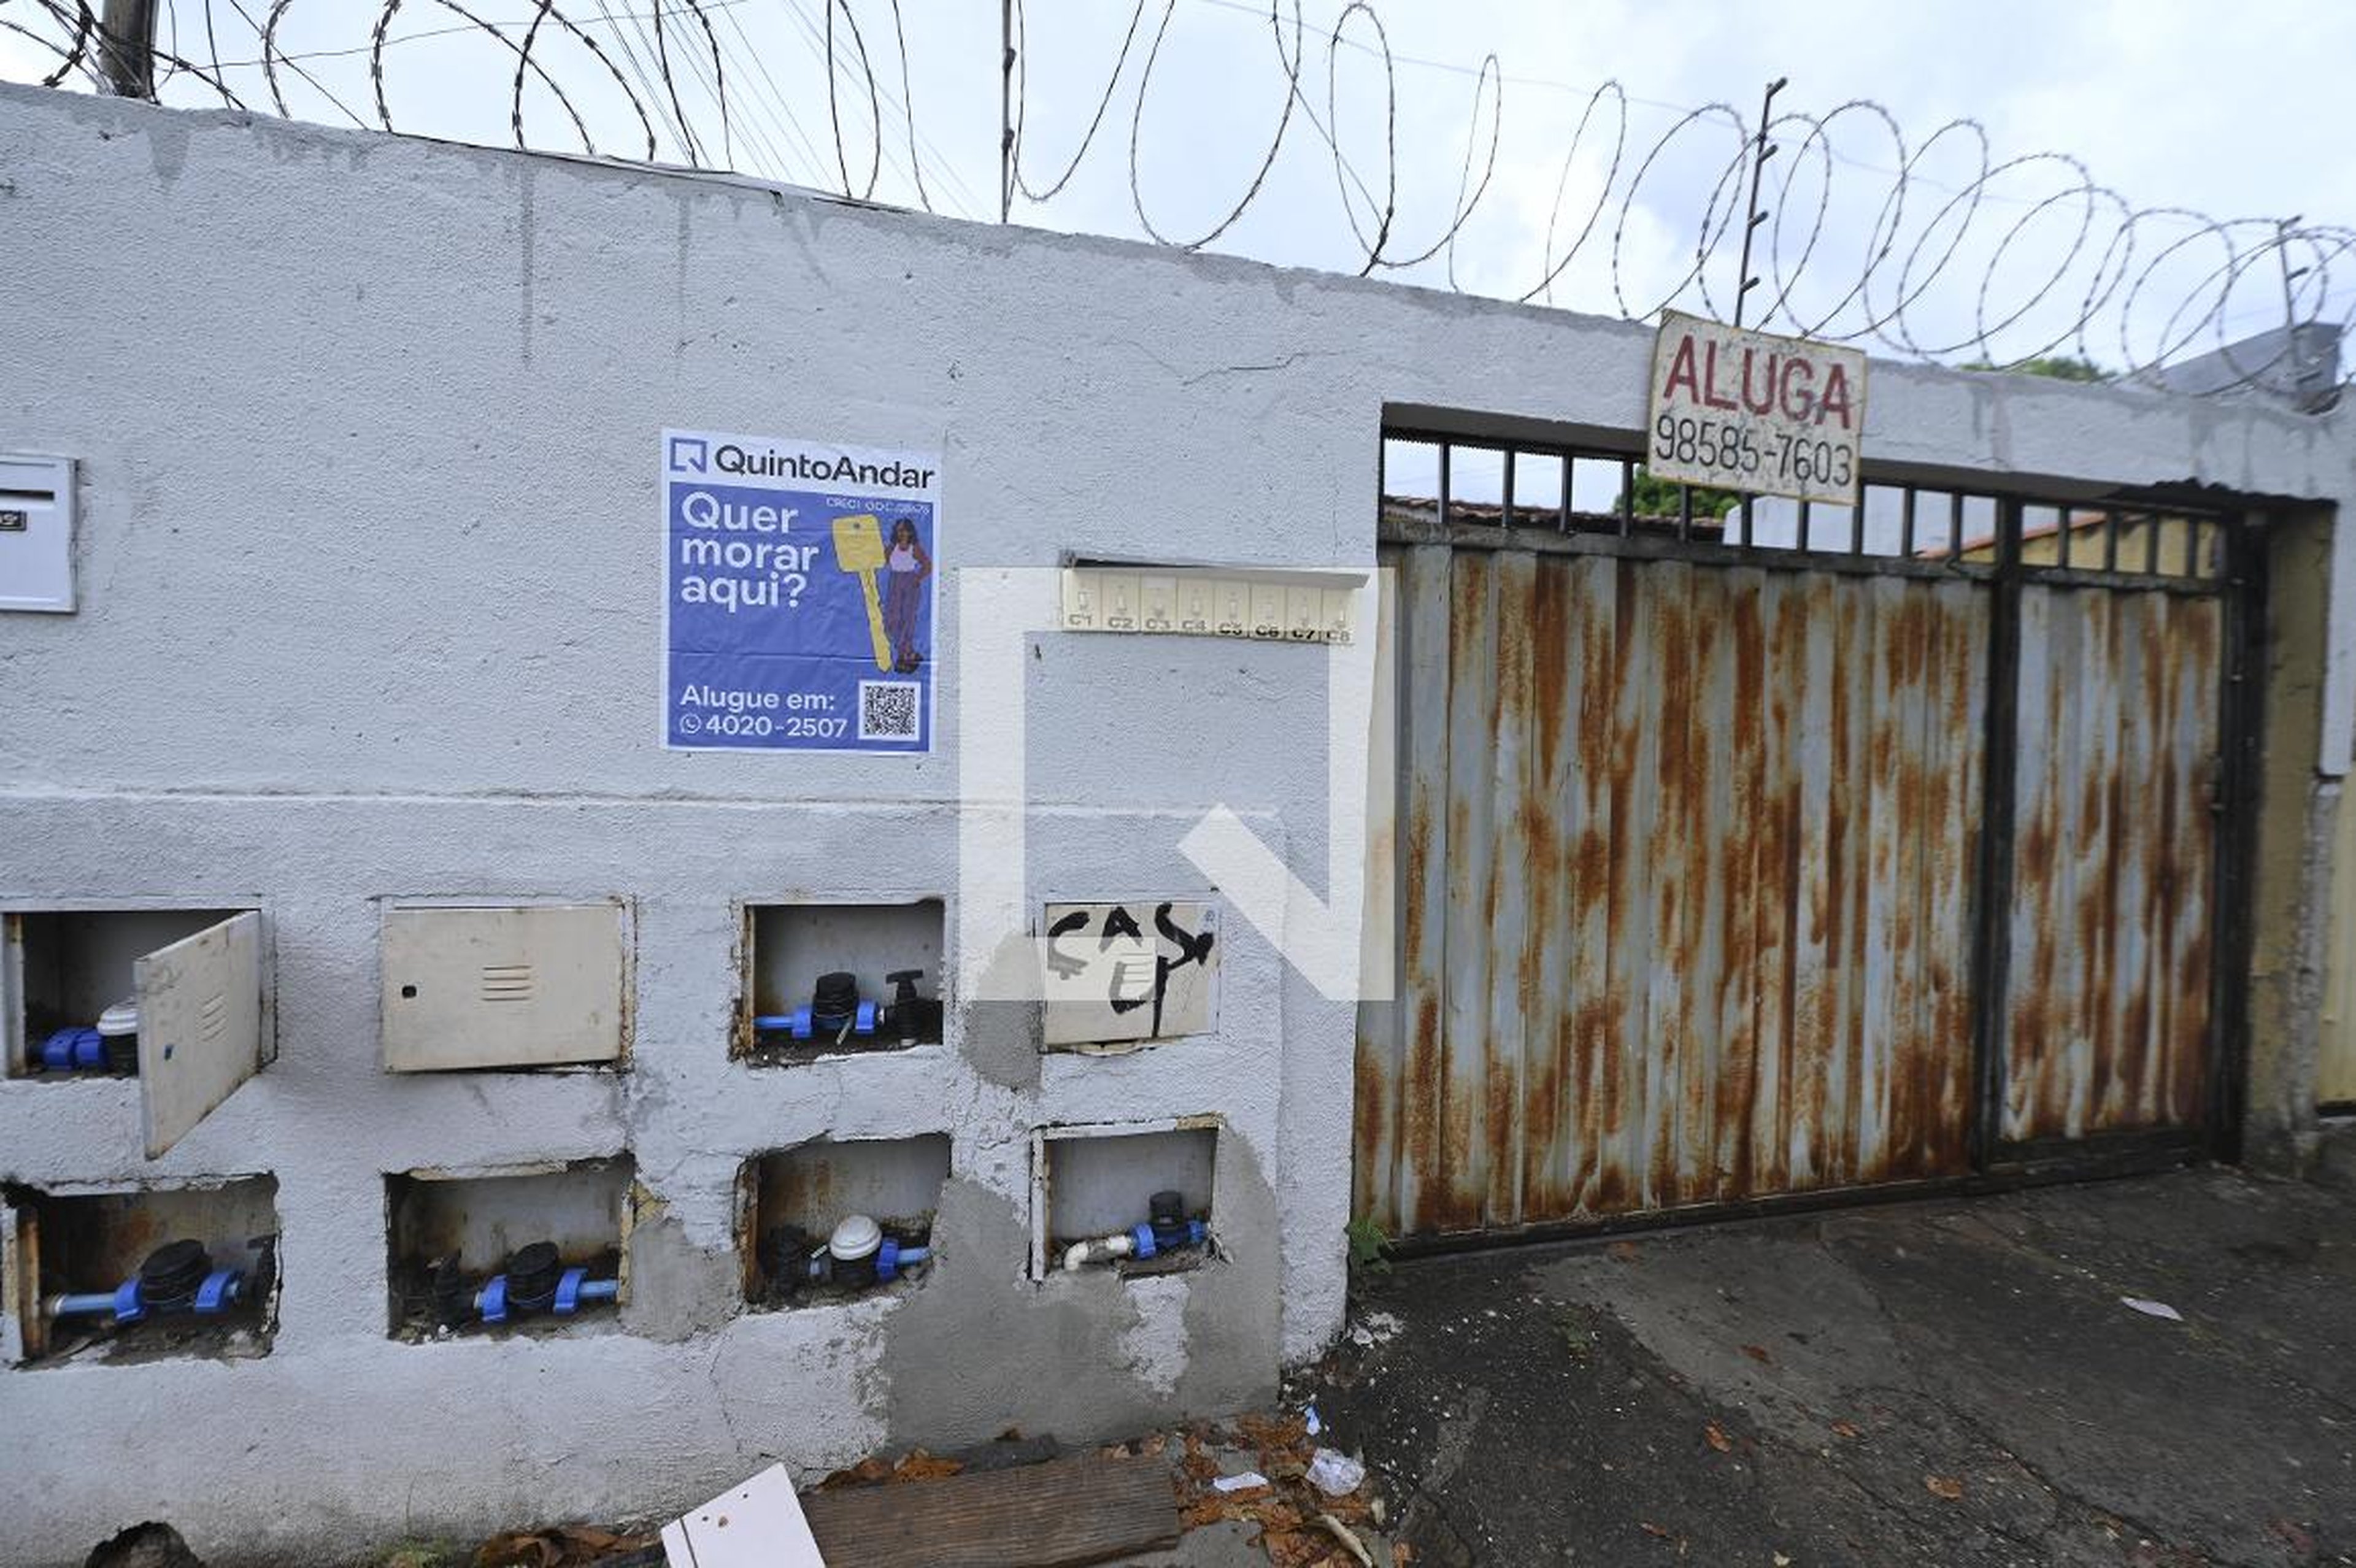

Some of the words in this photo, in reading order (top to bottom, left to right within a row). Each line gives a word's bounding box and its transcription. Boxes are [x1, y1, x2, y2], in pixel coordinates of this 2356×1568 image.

[1663, 334, 1850, 429] ALUGA
[715, 444, 935, 488] QuintoAndar
[1657, 413, 1852, 486] 98585-7603
[682, 491, 799, 533] Quer
[682, 537, 818, 572] morar
[680, 571, 807, 613] aqui?
[1108, 617, 1133, 630] C2
[1181, 619, 1206, 632] C4
[1255, 624, 1279, 638] C6
[1292, 627, 1315, 640] C7
[680, 685, 780, 713] Alugue
[787, 693, 834, 710] em:
[706, 715, 848, 737] 4020-2507
